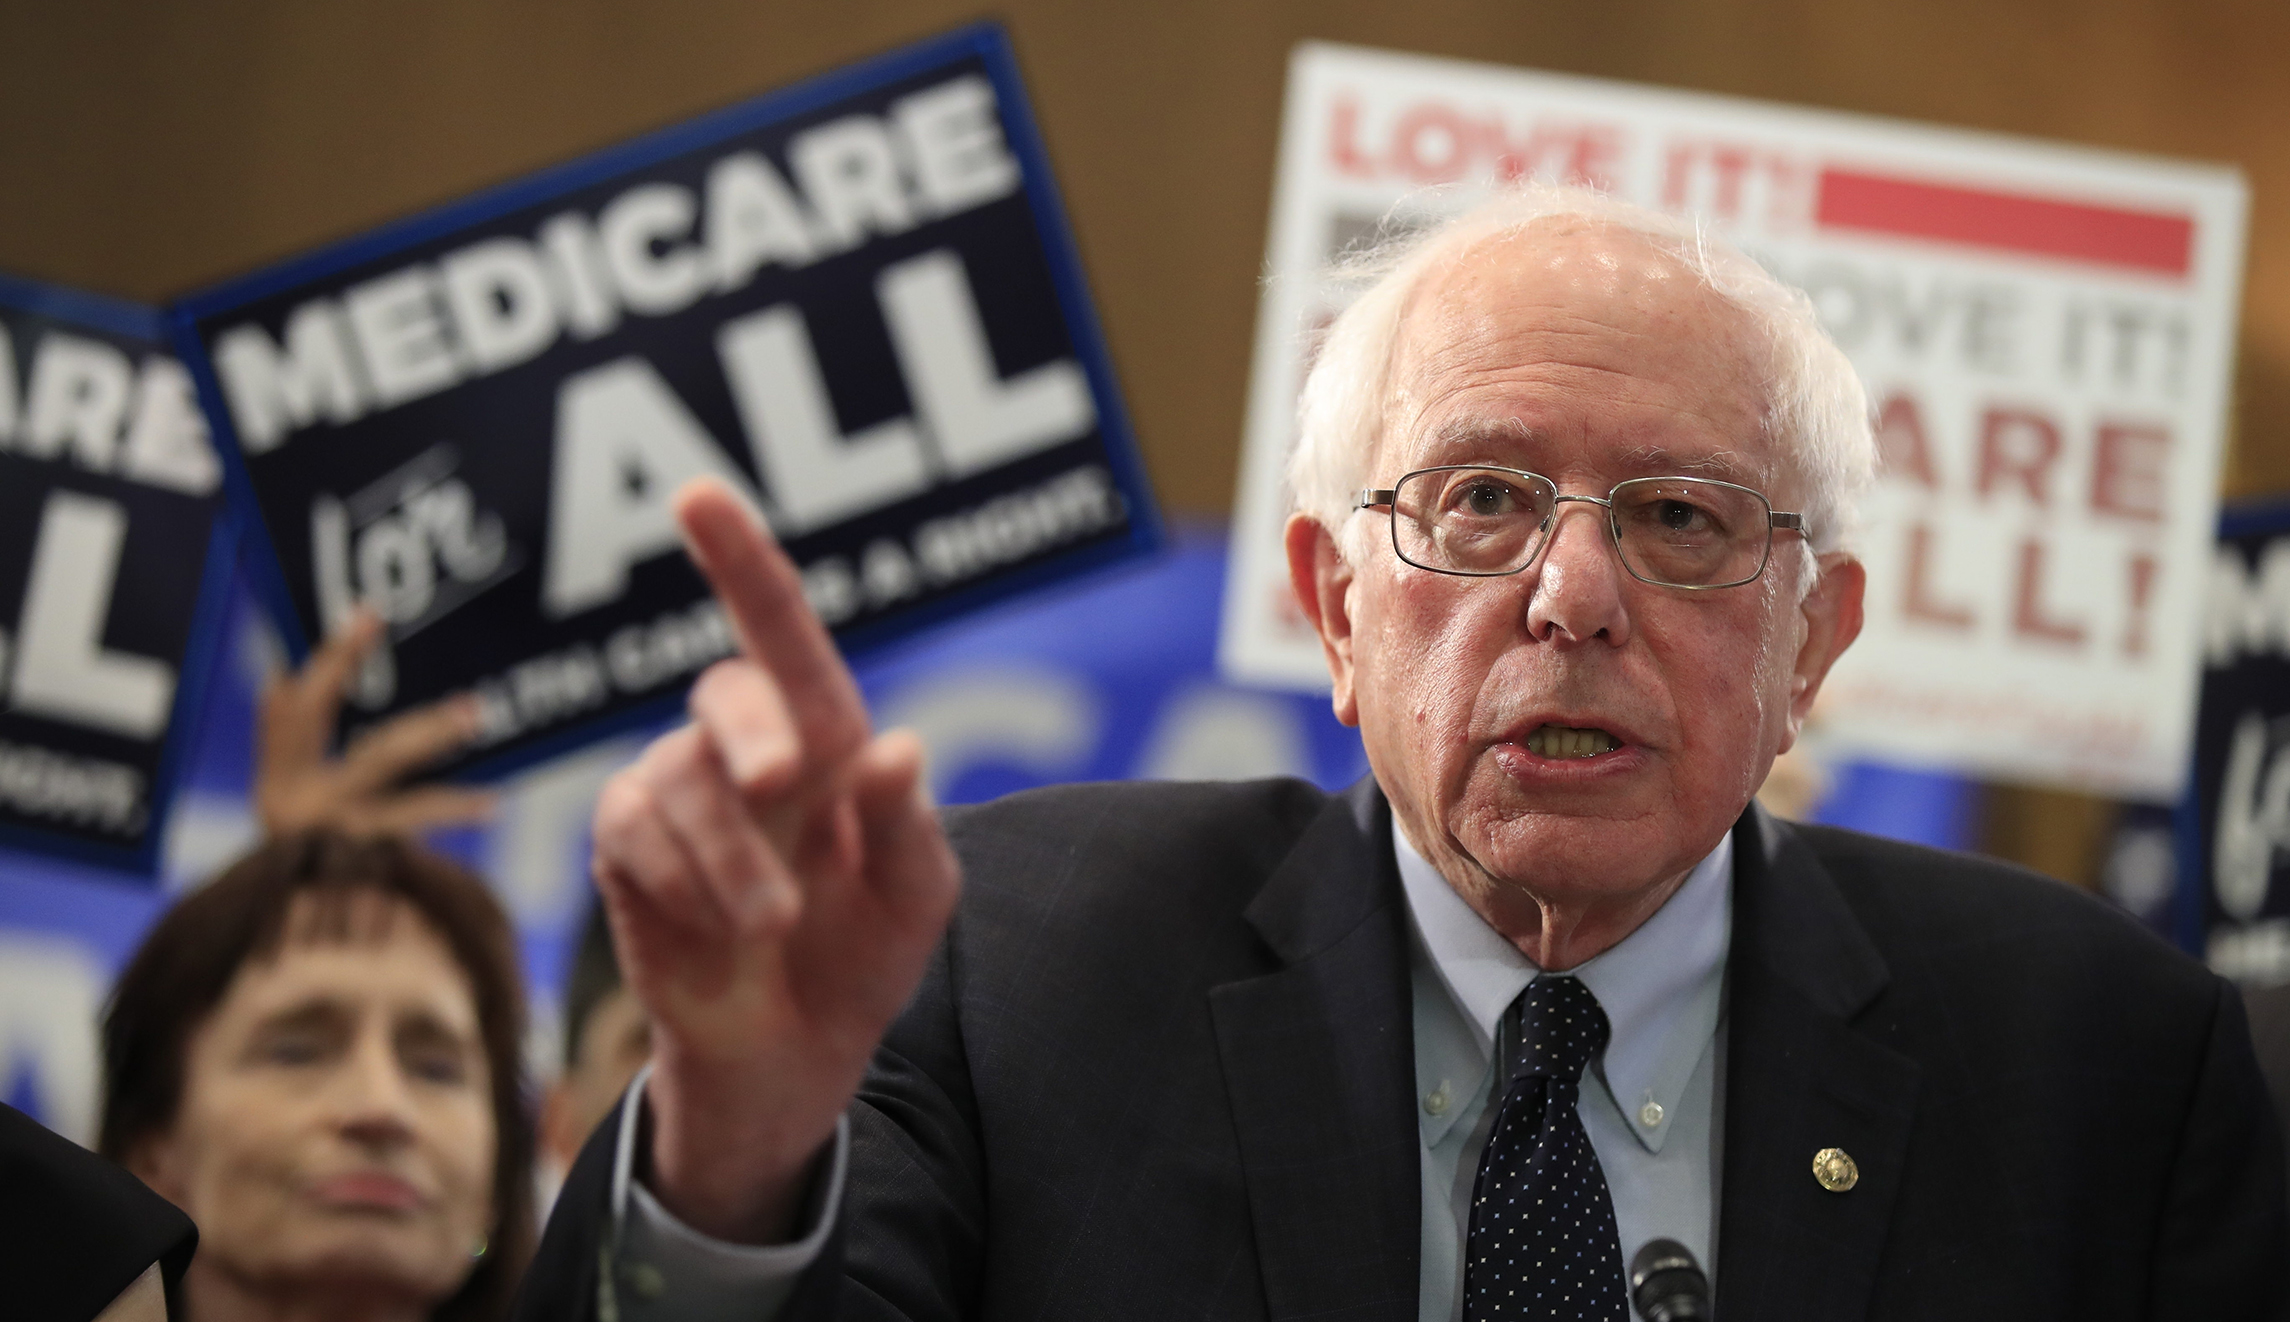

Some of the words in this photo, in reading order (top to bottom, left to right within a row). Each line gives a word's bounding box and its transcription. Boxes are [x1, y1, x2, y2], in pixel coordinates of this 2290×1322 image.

[212, 72, 1022, 454] MEDICARE
[1326, 90, 1628, 190] LOVE
[540, 246, 1098, 622] ALL
[1796, 262, 2020, 375] OVE
[2060, 300, 2193, 398] IT!
